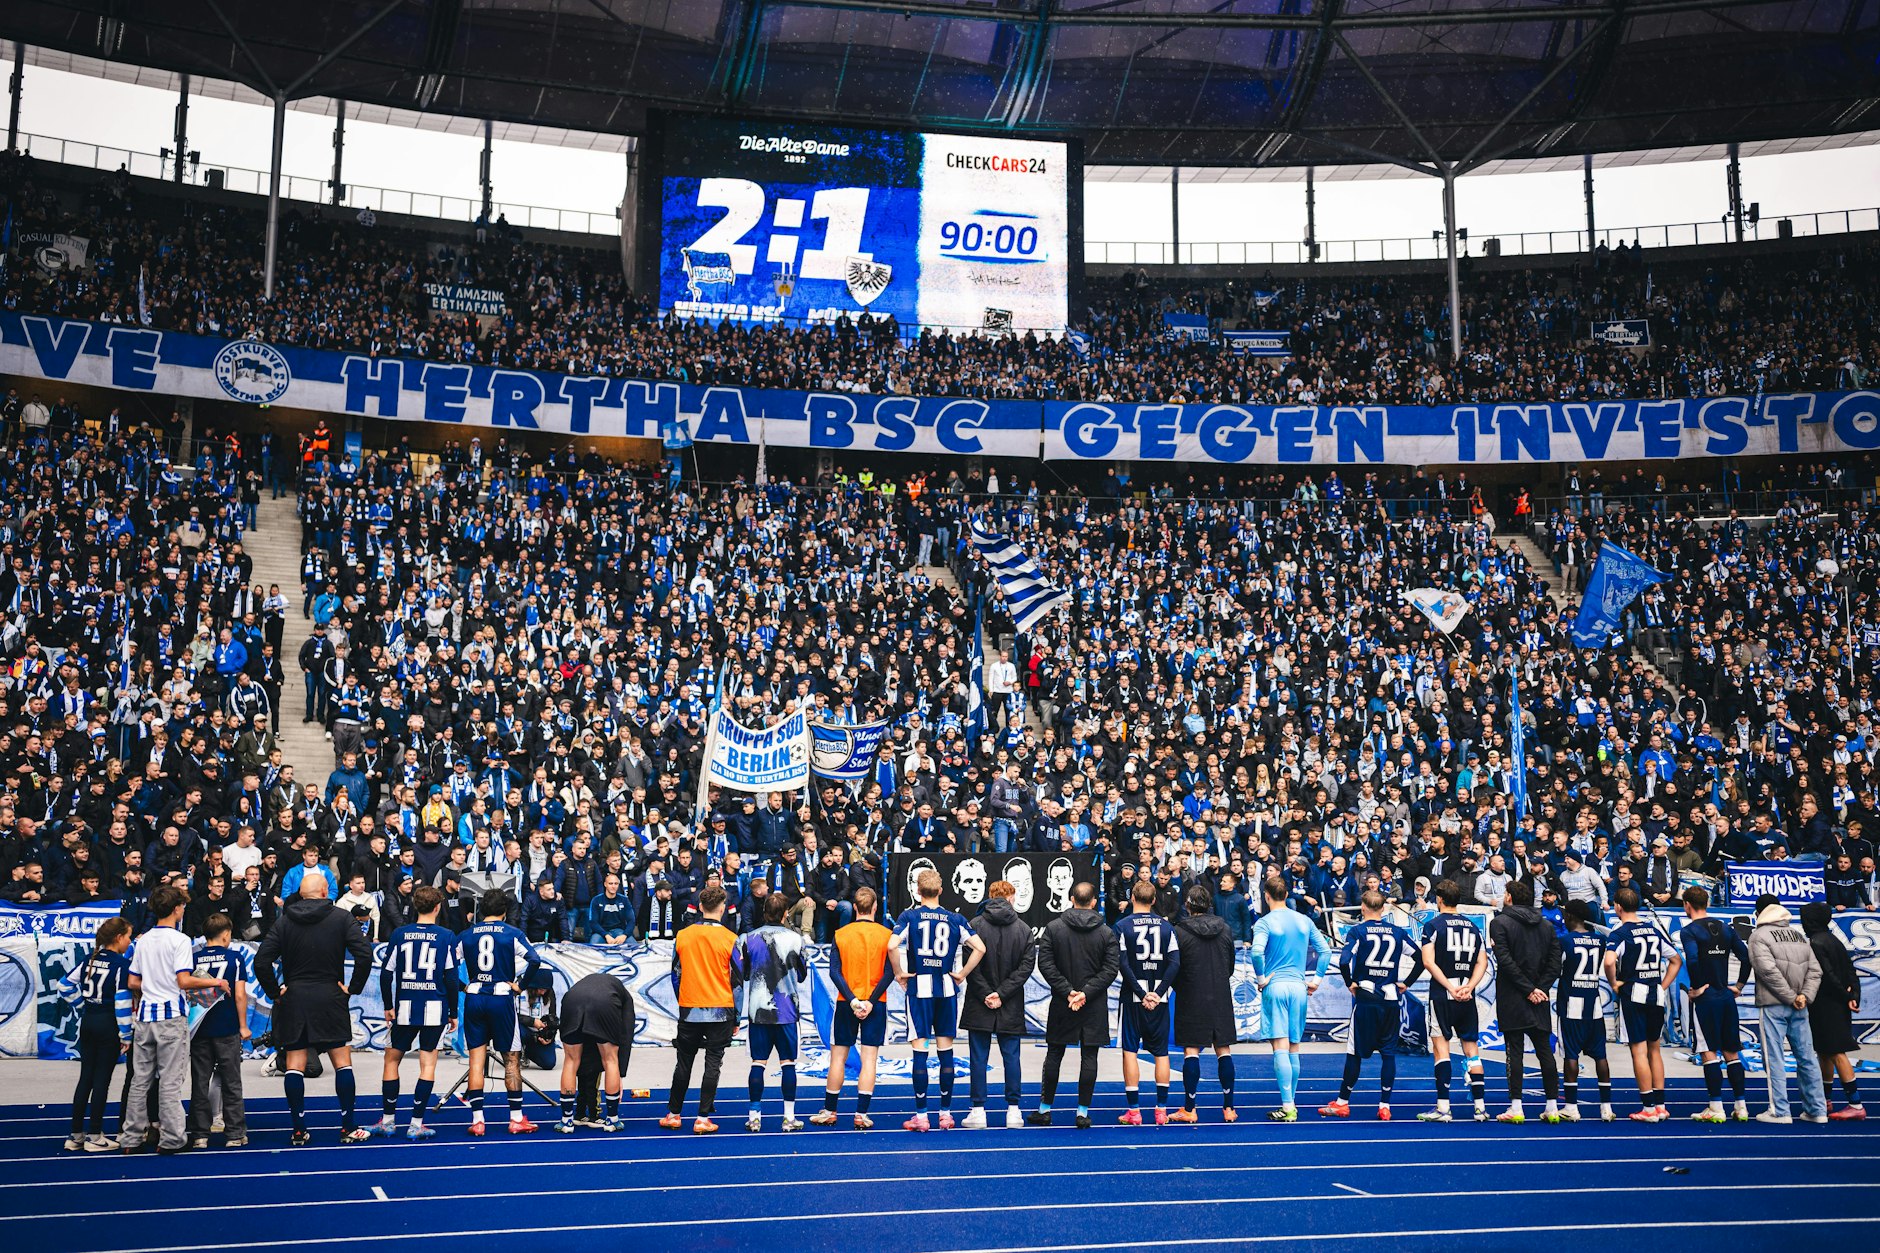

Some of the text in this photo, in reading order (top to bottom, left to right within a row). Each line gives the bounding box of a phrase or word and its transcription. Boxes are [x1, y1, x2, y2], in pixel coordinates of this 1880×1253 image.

[783, 155, 806, 164] 1892
[20, 232, 87, 252] CASUAL KUTTEN
[682, 177, 874, 281] 2:1
[940, 221, 1038, 255] 90:00
[222, 344, 283, 370] OSTKURVE
[1236, 338, 1278, 347] KIEZGÄNGER
[0, 316, 163, 390] VE
[341, 355, 751, 443] HERTHA
[805, 391, 990, 452] BSC
[1061, 401, 1389, 463] GEGEN
[718, 711, 773, 749] GRUPPA
[712, 761, 723, 775] HA
[736, 774, 749, 783] HE
[755, 770, 791, 784] HERTHA
[792, 764, 807, 777] BSC
[727, 745, 791, 773] BERLIN
[404, 932, 437, 941] HERTHA BSC
[473, 925, 505, 934] HERTHA BSC
[917, 920, 950, 958] 18
[1132, 925, 1164, 961] 31
[1446, 927, 1477, 962] 44
[400, 941, 437, 980] 14
[477, 934, 495, 972] 8
[1365, 934, 1396, 969] 22
[1573, 946, 1600, 981] 21
[1633, 935, 1661, 971] 23
